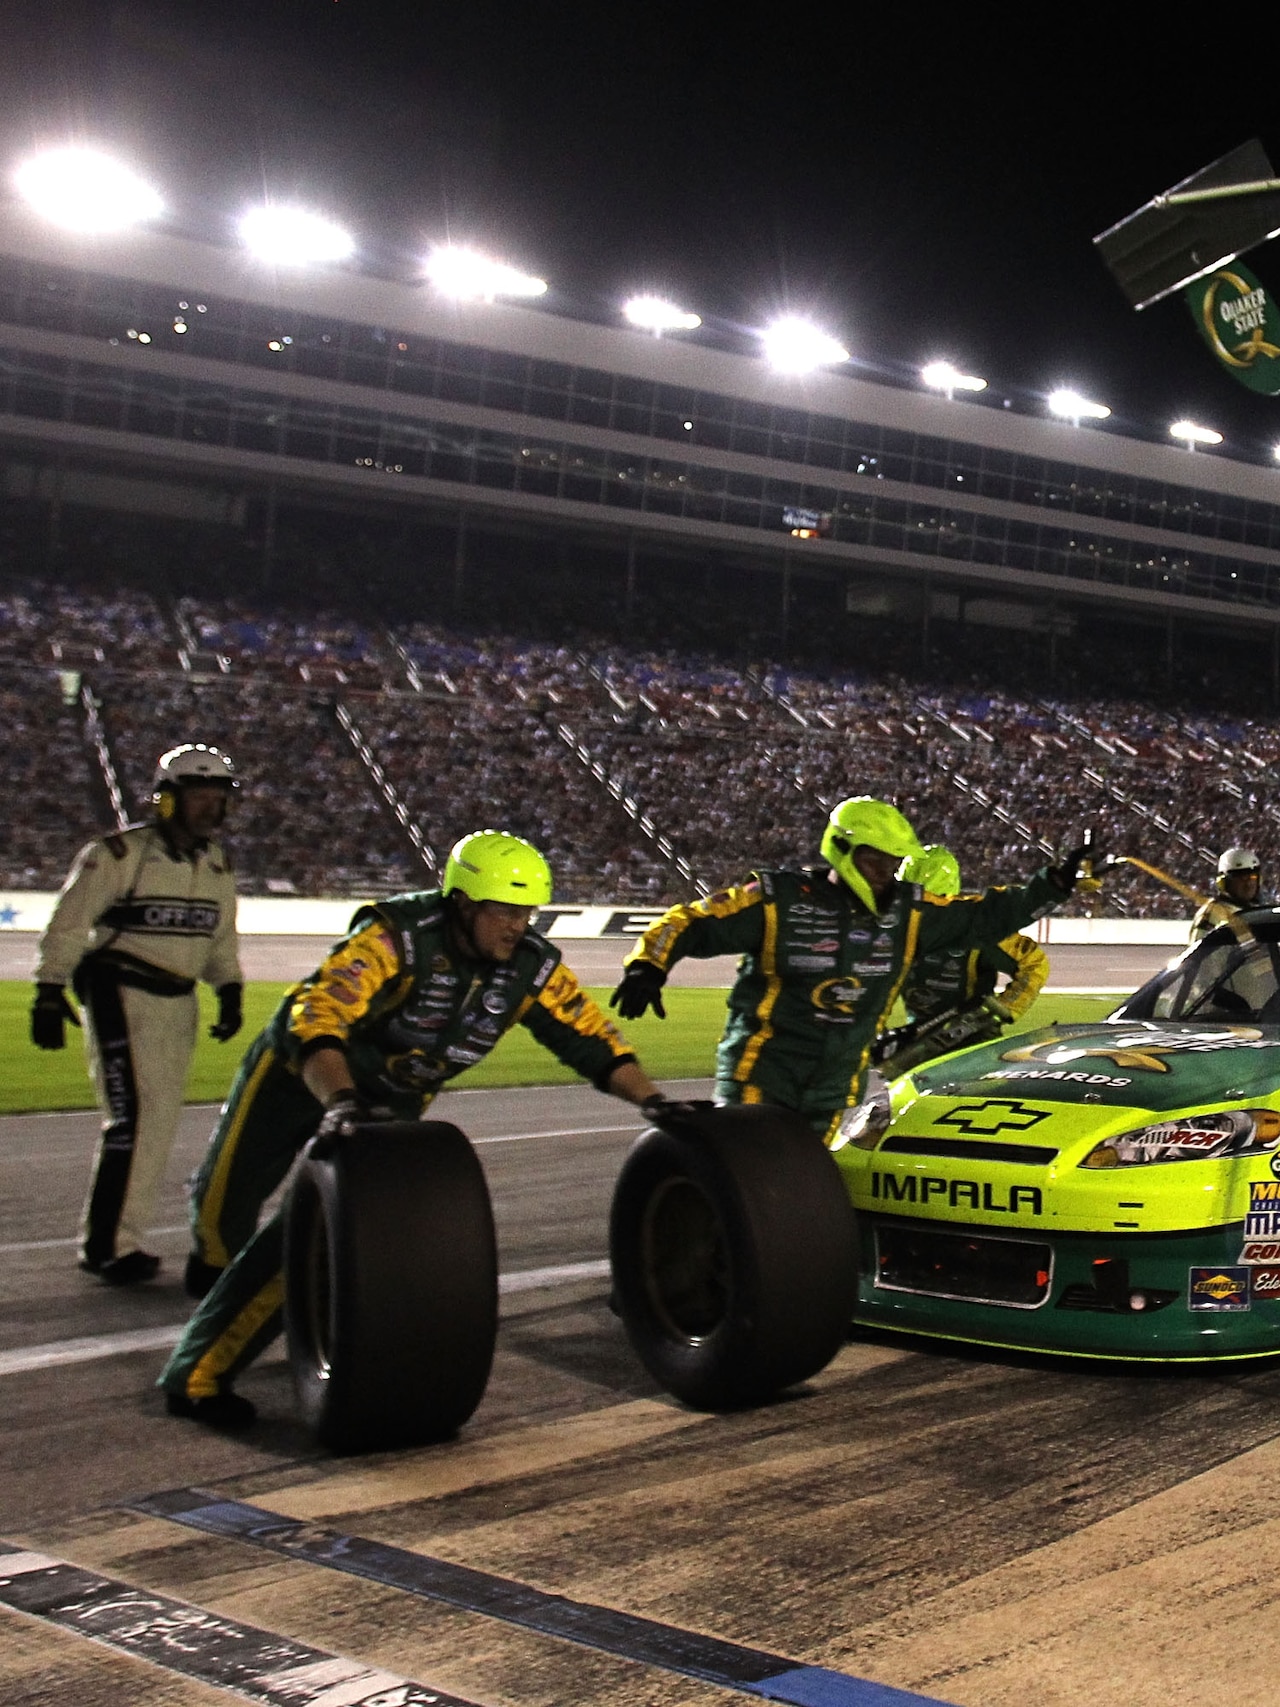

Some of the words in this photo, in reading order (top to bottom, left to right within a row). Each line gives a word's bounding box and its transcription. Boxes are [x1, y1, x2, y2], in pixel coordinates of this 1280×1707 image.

[1219, 287, 1267, 323] QUAKER
[1233, 307, 1267, 335] STATE
[979, 1070, 1132, 1087] MENARDS
[872, 1172, 1044, 1216] IMPALA
[1194, 1281, 1246, 1293] SUNOCO
